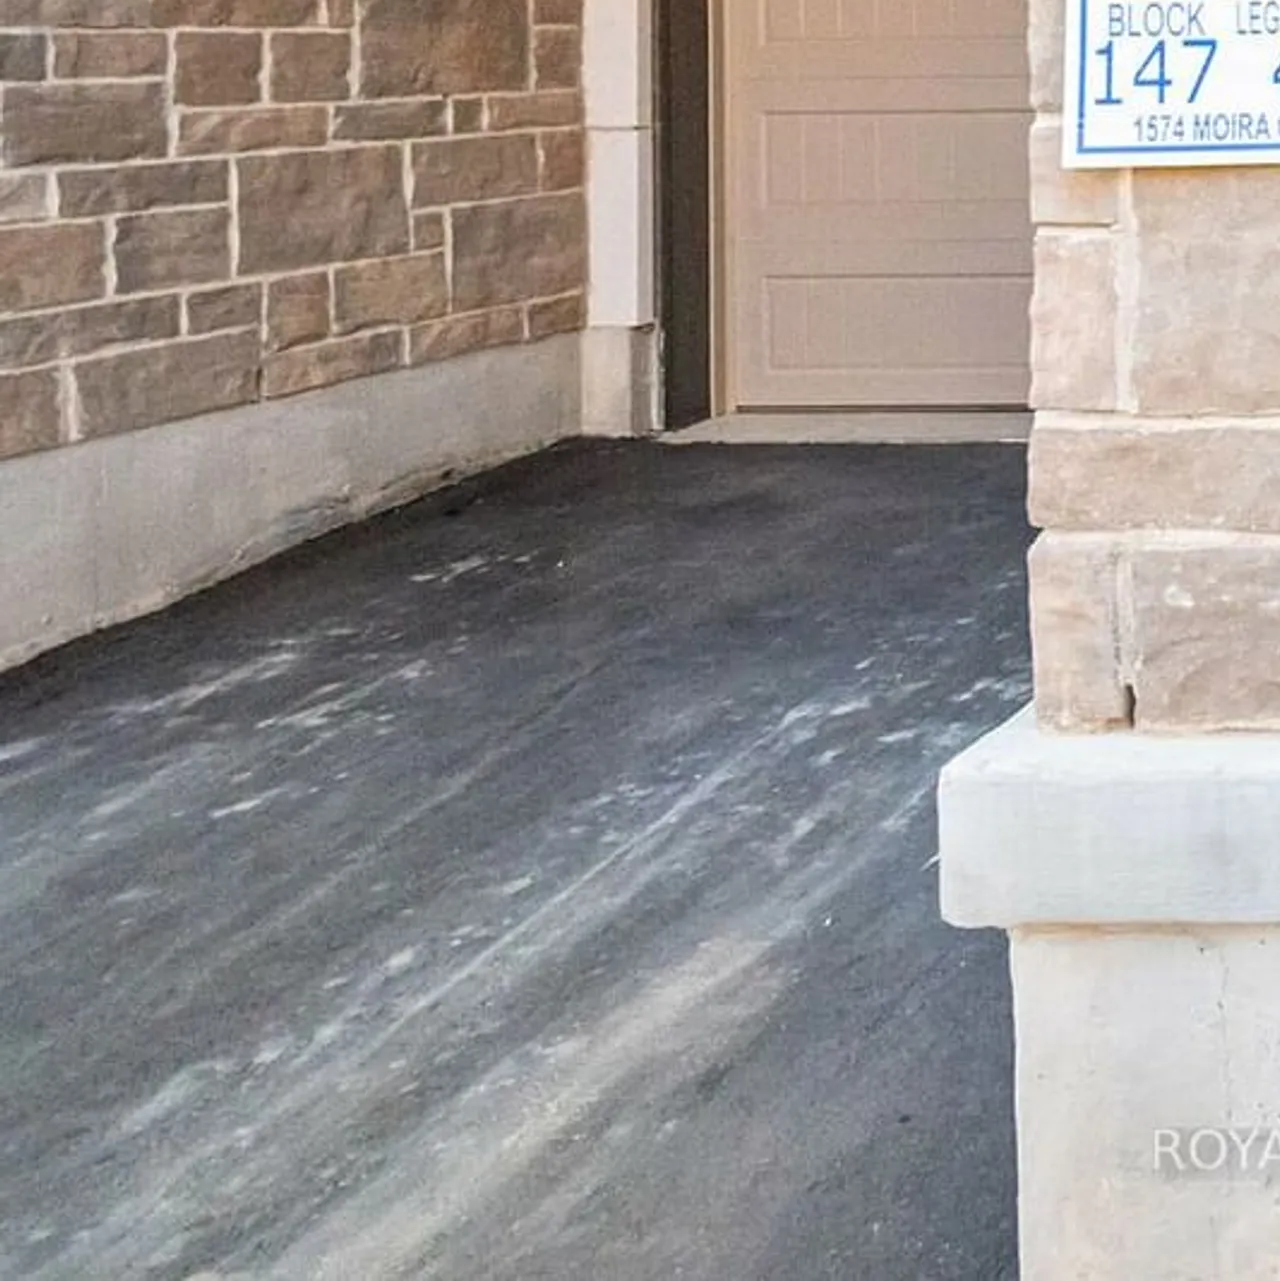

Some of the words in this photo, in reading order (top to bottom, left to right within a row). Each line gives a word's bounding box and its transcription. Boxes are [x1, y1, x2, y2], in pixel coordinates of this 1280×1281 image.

[1108, 3, 1206, 37] BLOCK
[1095, 39, 1218, 105] 147
[1133, 114, 1185, 142] 1574
[1192, 111, 1271, 141] MOIRA
